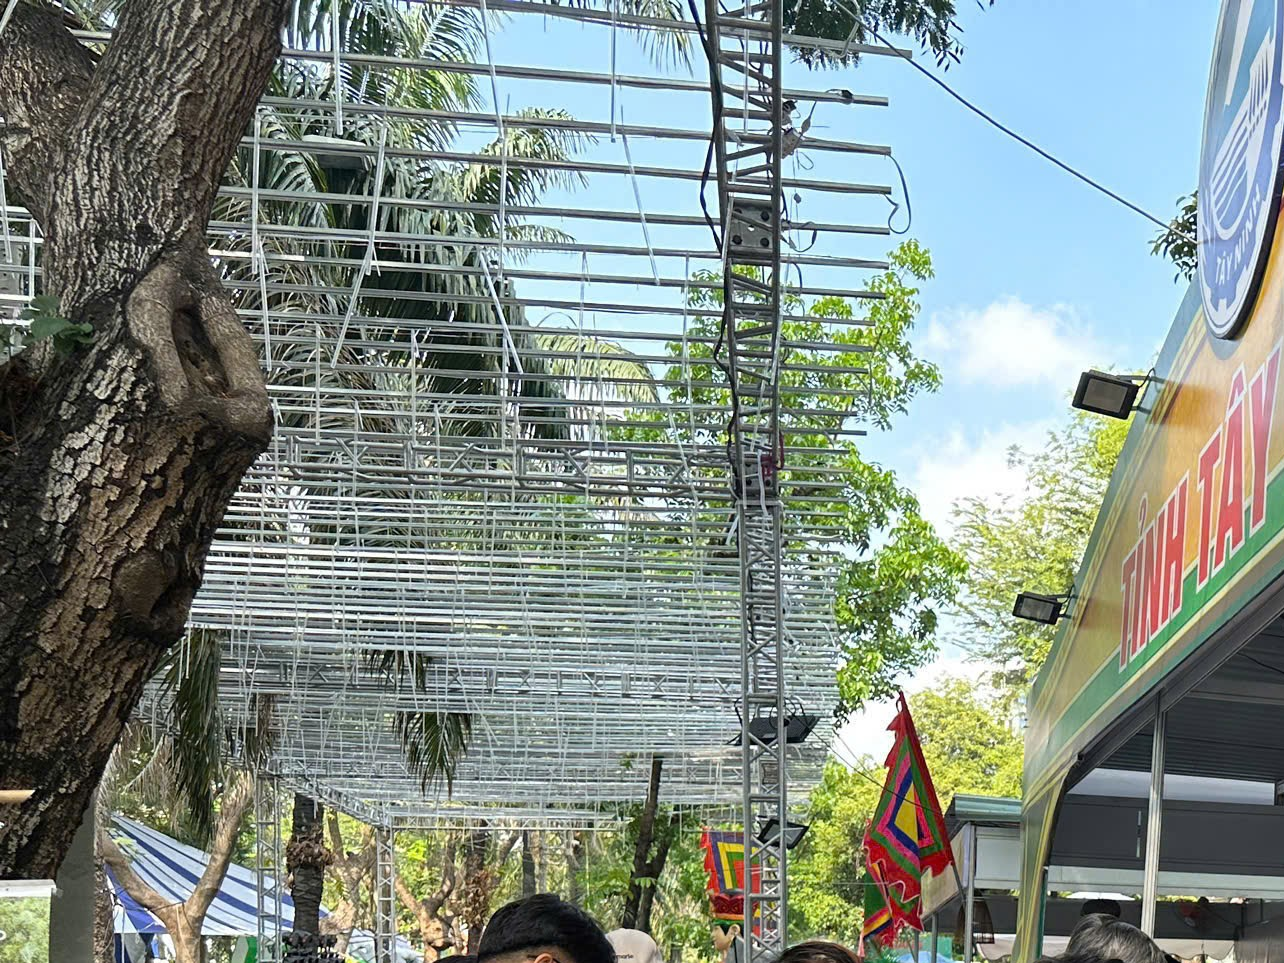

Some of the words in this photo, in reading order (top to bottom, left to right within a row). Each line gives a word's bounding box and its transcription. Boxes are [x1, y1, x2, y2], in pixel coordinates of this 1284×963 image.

[1234, 183, 1260, 270] NINH
[1118, 470, 1191, 673] TỈNH
[1196, 343, 1283, 592] TÂY
